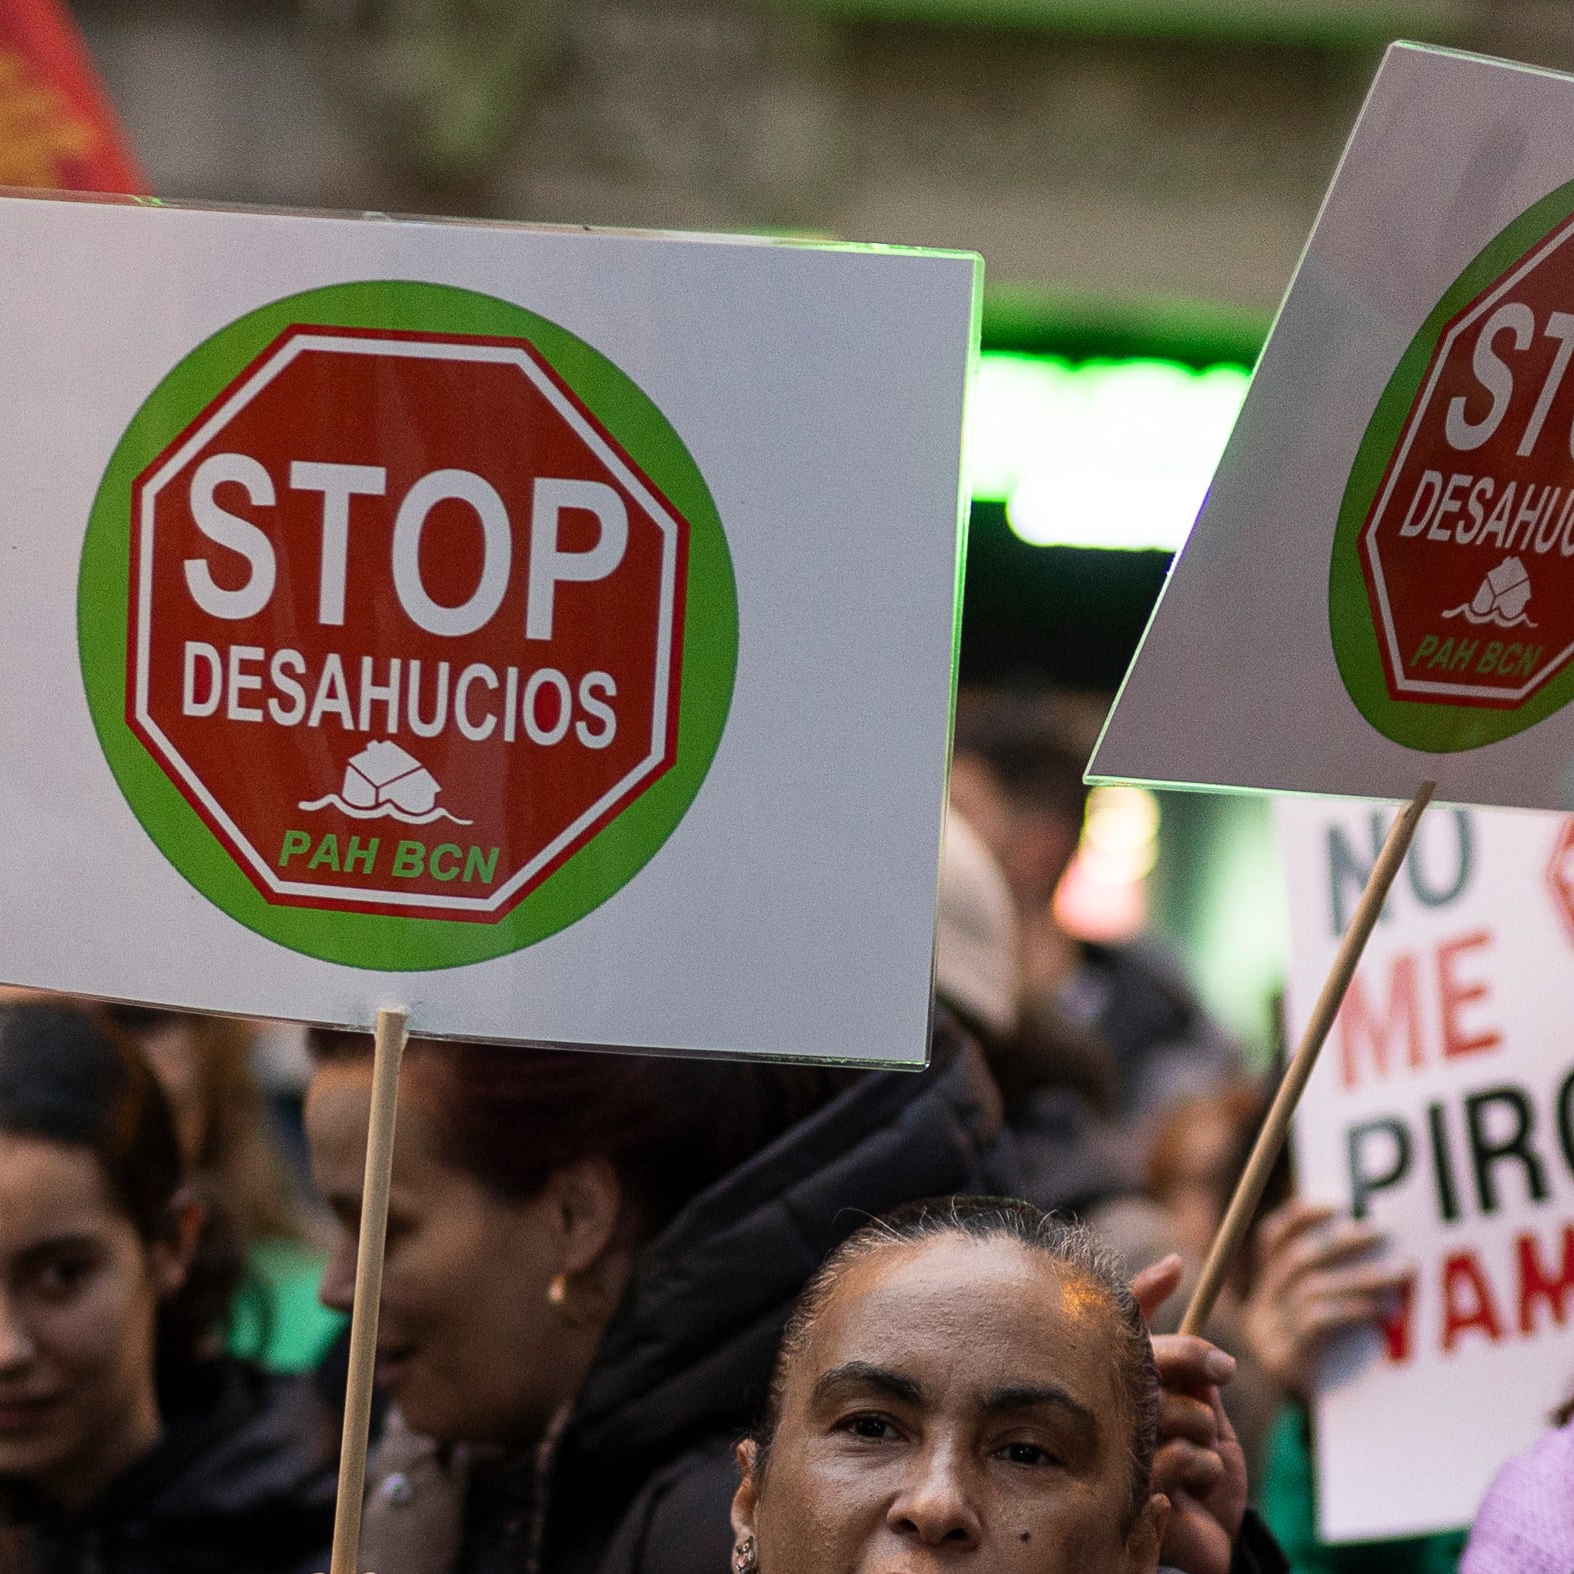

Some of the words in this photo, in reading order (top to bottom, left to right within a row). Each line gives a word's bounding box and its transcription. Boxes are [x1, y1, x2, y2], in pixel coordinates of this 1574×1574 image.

[183, 453, 629, 642] STOP
[182, 641, 617, 749] DESAHUCIOS
[1411, 635, 1477, 674] PAH
[1477, 641, 1546, 679] BCN
[277, 829, 380, 875] PAH
[392, 840, 501, 885] BCN
[1323, 804, 1481, 940] NO
[1336, 928, 1505, 1092] ME
